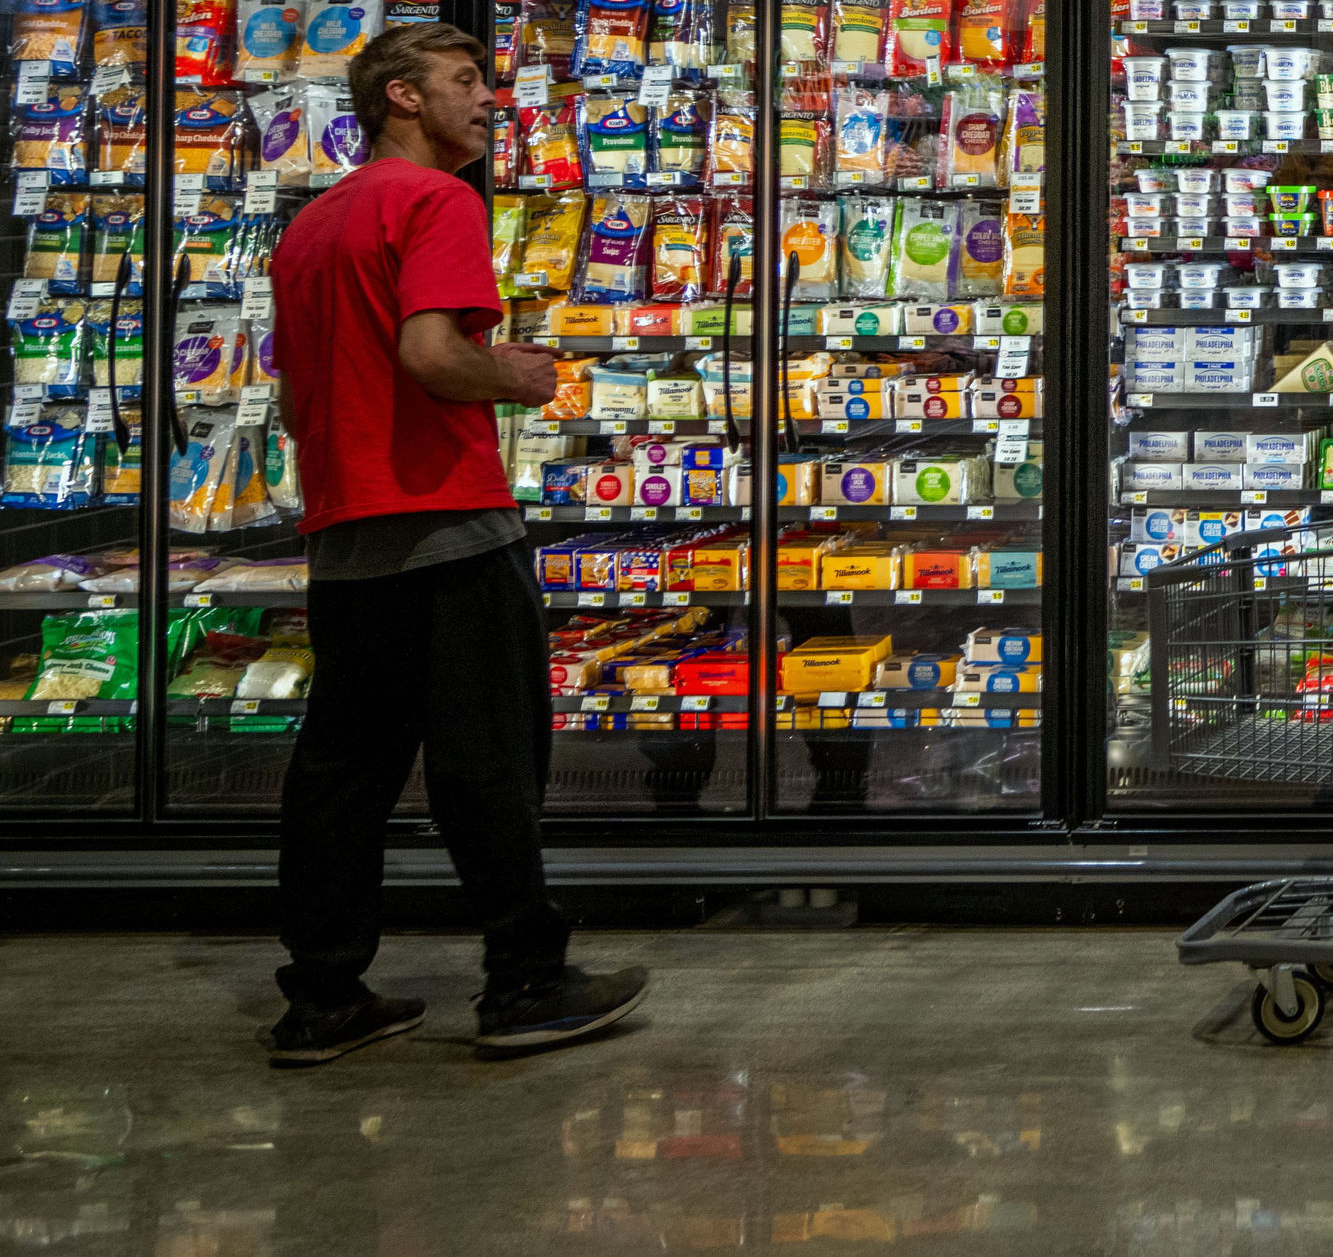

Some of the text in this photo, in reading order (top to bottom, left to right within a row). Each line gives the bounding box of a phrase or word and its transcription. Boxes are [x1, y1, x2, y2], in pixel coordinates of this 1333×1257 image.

[391, 3, 439, 15] SARGENTO
[900, 4, 943, 18] Borden
[962, 3, 1003, 17] Borden
[565, 316, 598, 324] Tillamook
[1136, 340, 1174, 349] PHILADELPHIA
[1135, 374, 1174, 384] PHILADELPHIA
[1195, 374, 1233, 384] PHILADELPHIA
[659, 386, 694, 395] Tillamook
[1133, 472, 1172, 480] PHILADELPHIA
[1192, 472, 1231, 480] PHILADELPHIA
[834, 567, 872, 579] Tillamook
[802, 658, 841, 668] Tillamook
